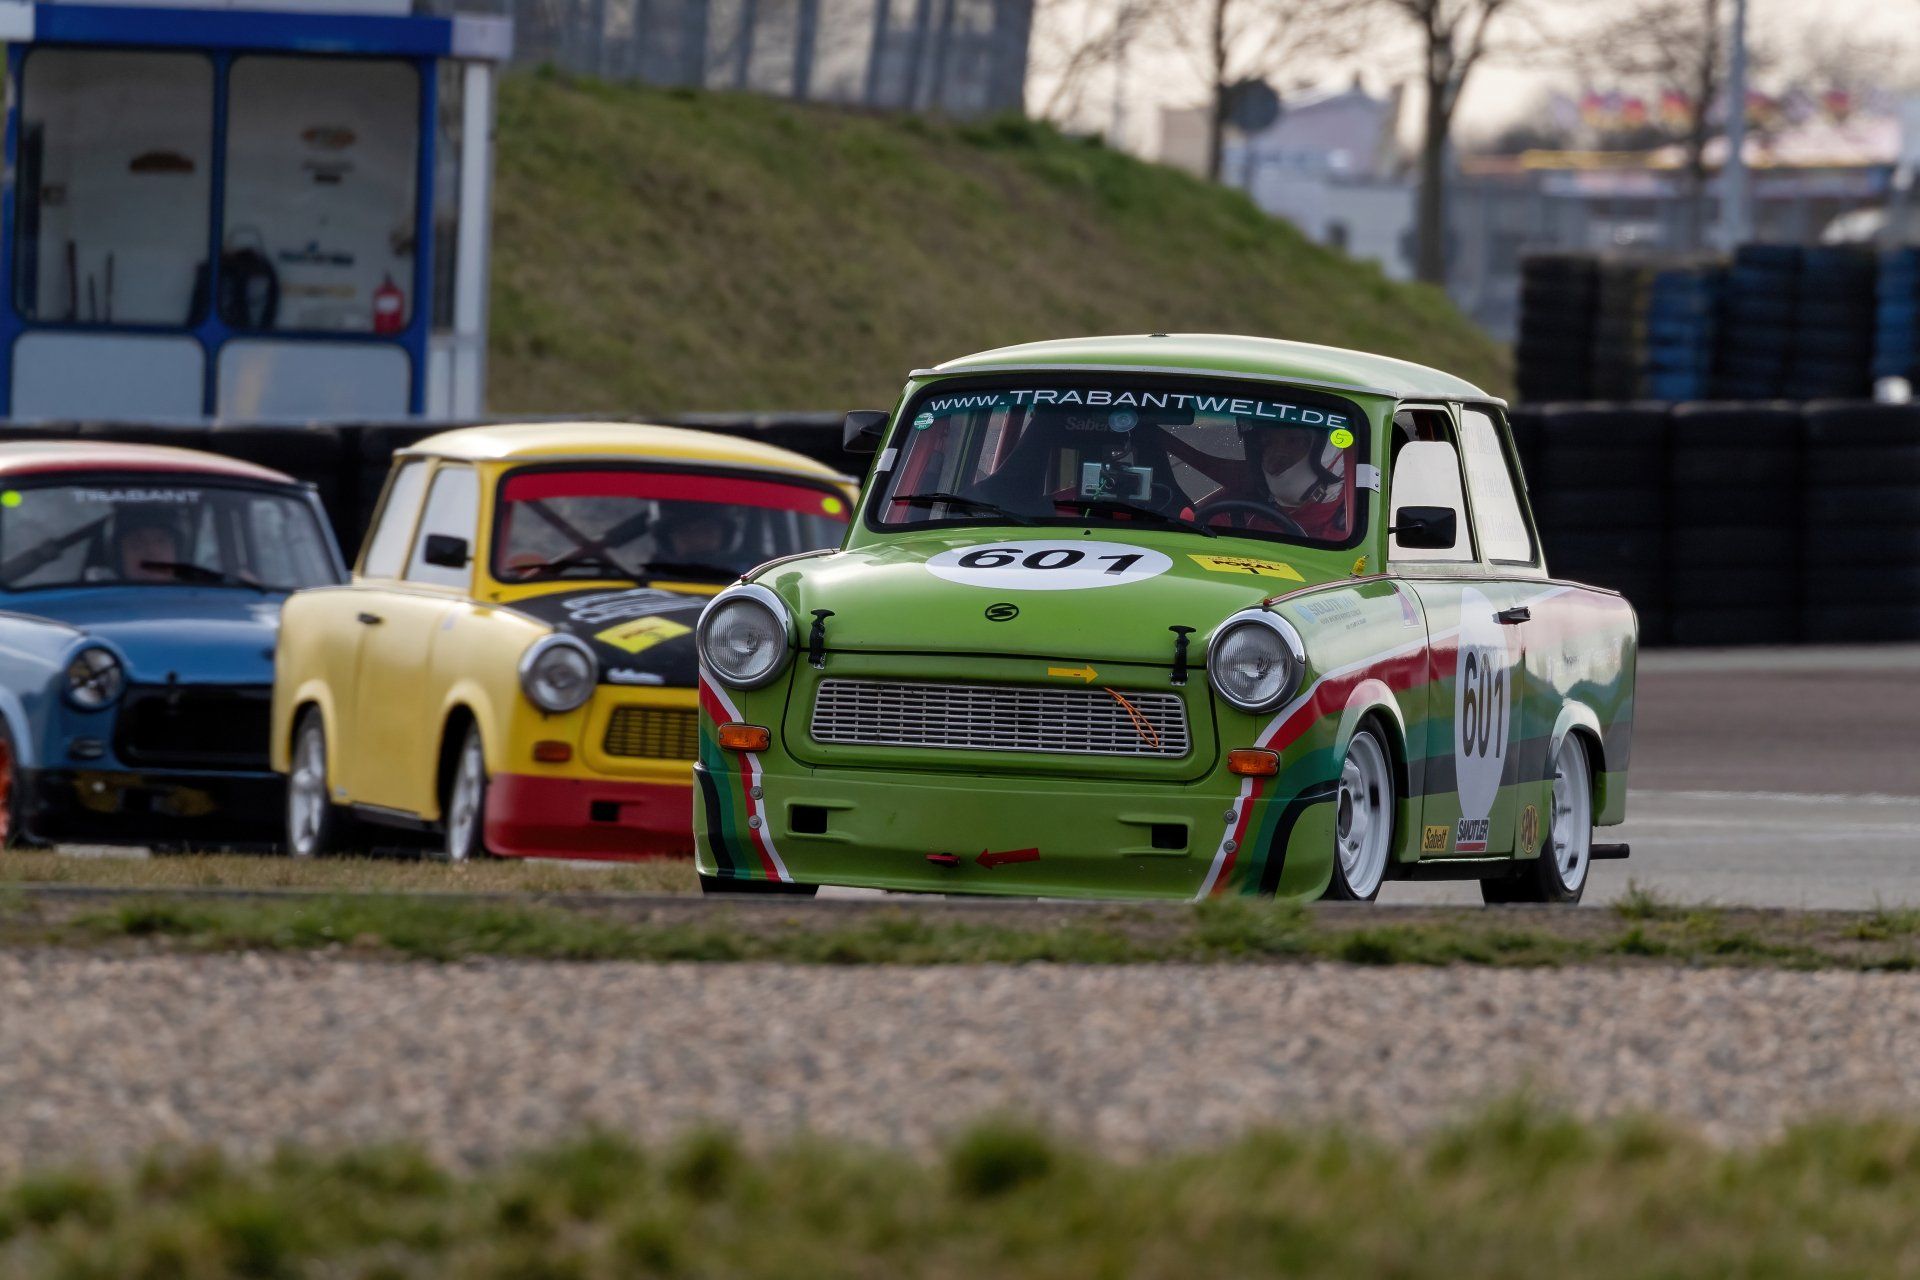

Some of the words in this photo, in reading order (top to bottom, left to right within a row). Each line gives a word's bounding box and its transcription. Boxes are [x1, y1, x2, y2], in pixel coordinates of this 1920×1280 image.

[1064, 416, 1110, 432] Sabe
[958, 548, 1144, 575] 601
[1462, 652, 1504, 758] 601
[1424, 827, 1447, 849] Sabelt
